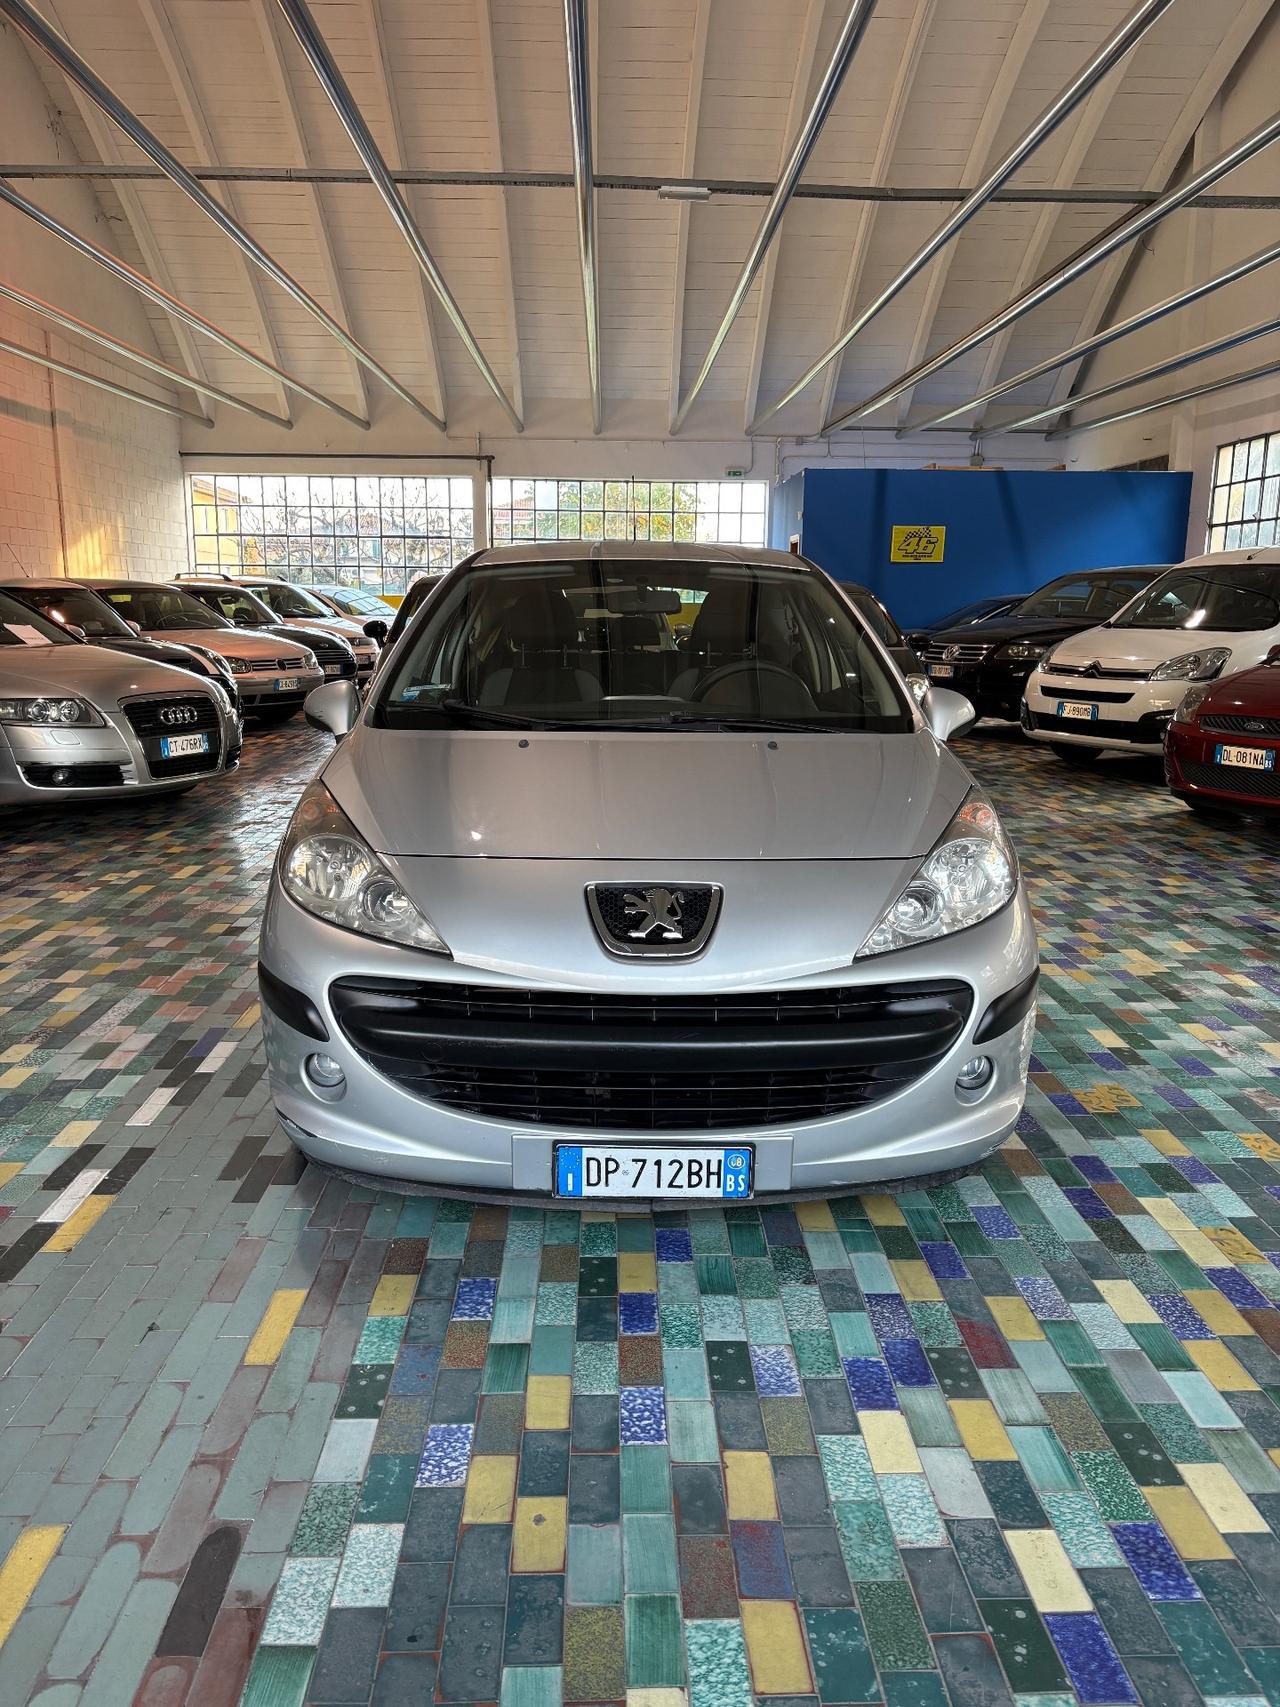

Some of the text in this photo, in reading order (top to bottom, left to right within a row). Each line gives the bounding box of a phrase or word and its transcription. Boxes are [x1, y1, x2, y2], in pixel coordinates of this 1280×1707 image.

[898, 536, 939, 554] 46
[1223, 749, 1264, 766] DL 081NA
[585, 1157, 723, 1189] DP 712BH
[726, 1174, 745, 1192] BS
